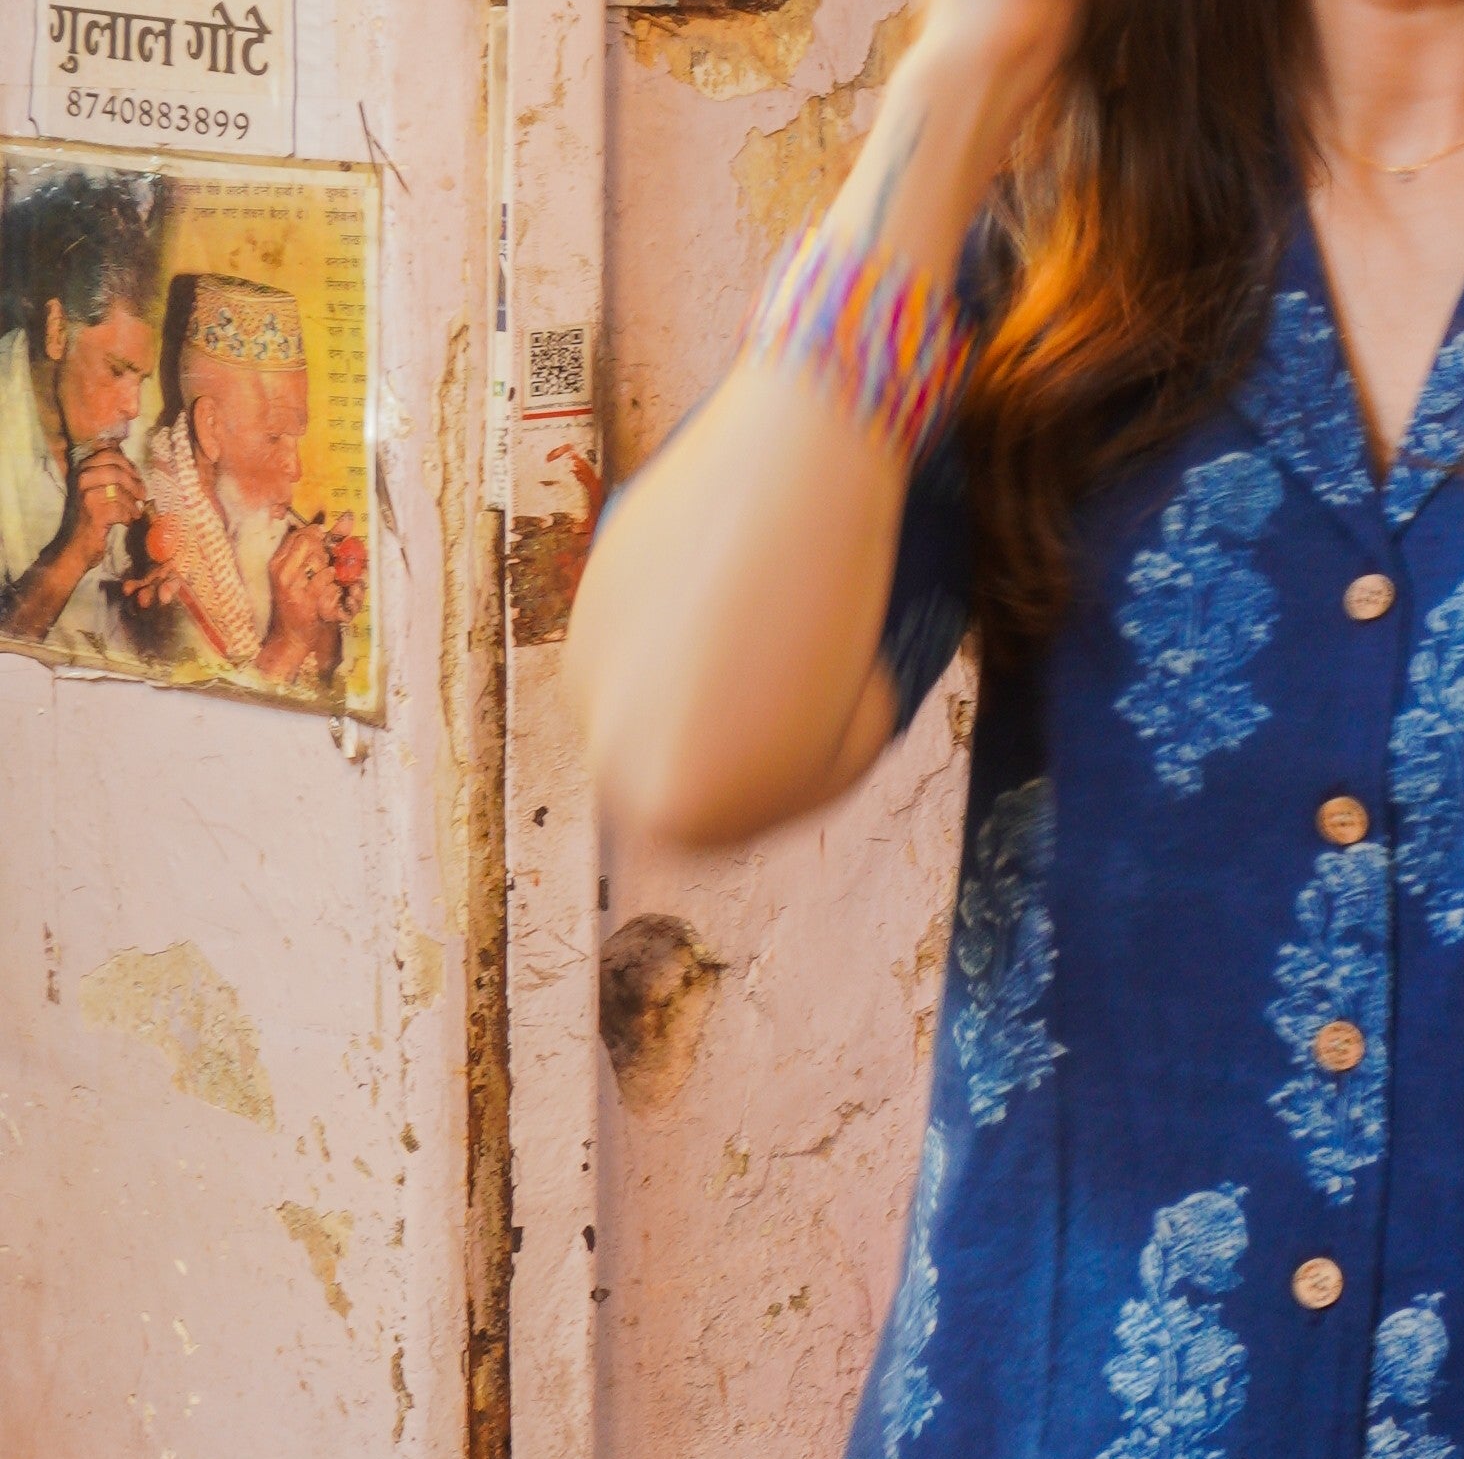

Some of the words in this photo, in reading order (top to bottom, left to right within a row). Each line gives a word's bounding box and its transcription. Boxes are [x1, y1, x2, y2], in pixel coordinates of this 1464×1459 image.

[49, 3, 175, 74] गुलाल
[184, 1, 273, 76] गोटे
[66, 90, 250, 140] 8740883899
